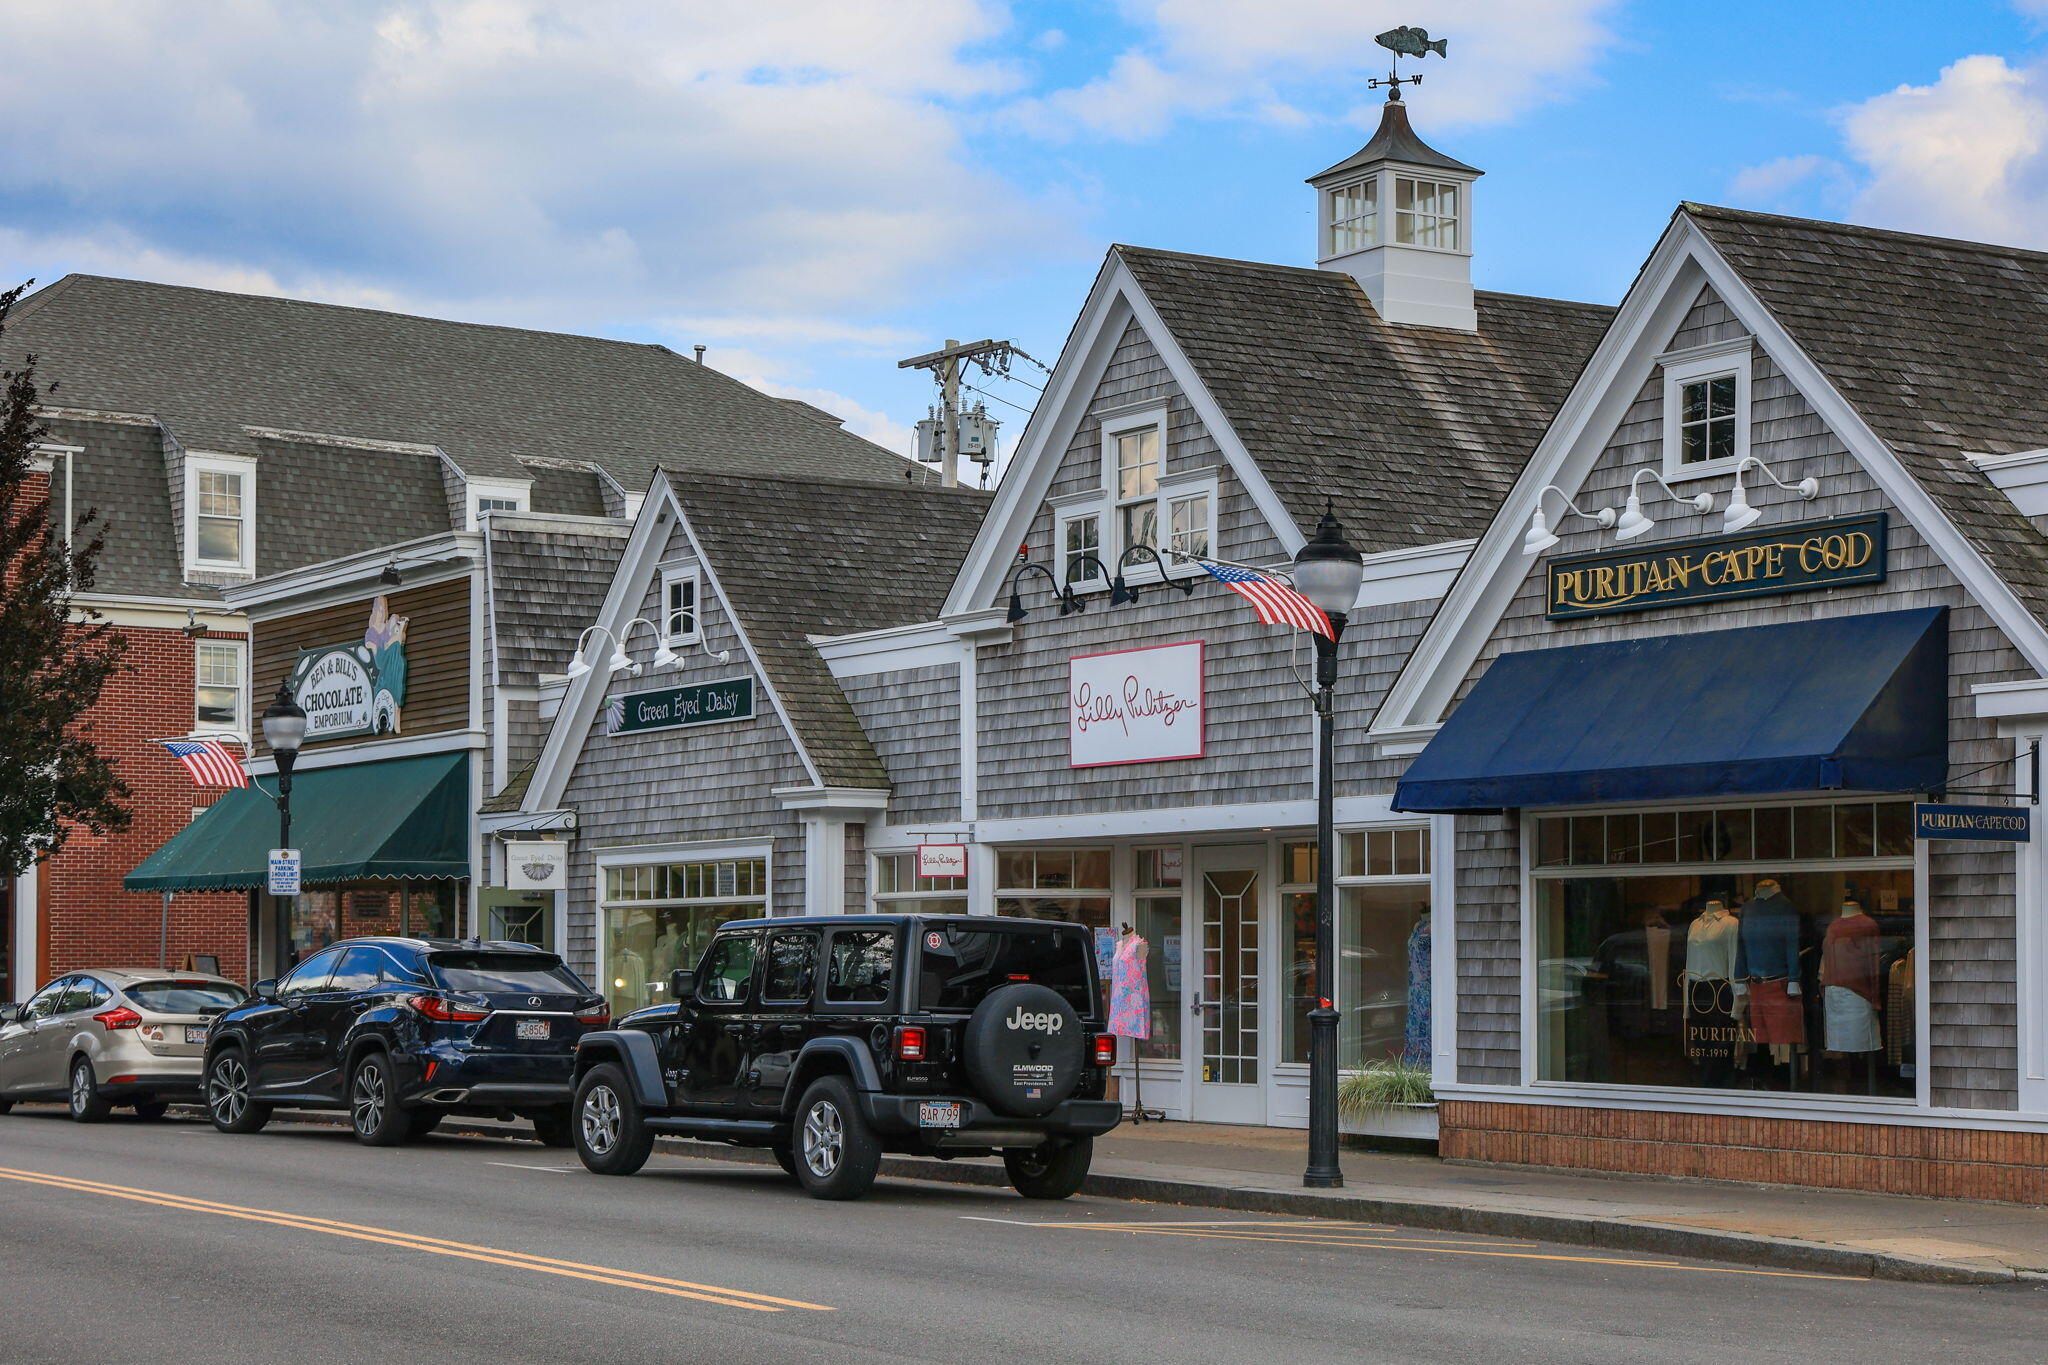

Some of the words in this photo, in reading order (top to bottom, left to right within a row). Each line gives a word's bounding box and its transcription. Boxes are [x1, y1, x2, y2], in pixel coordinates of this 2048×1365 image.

[1556, 555, 1692, 605] PURITAN
[1701, 543, 1785, 586] CAPE
[1799, 531, 1872, 574] COD
[310, 663, 326, 690] BEN
[327, 659, 334, 675] &
[335, 657, 358, 682] BILL'S
[304, 686, 363, 713] CHOCOLATE
[638, 701, 669, 722] Green
[673, 689, 701, 722] Eyed
[705, 689, 739, 716] Daisy
[1074, 682, 1128, 737] Lilly
[1123, 675, 1197, 726] Pulitzer
[314, 711, 353, 729] EMPORIUM
[1921, 813, 1974, 829] PURITAN
[1006, 1006, 1063, 1035] Jeep
[1690, 1026, 1757, 1042] PURITAN
[1012, 1064, 1054, 1072] ELMWOOD
[920, 1108, 939, 1121] 8AR
[940, 1108, 959, 1121] 799
